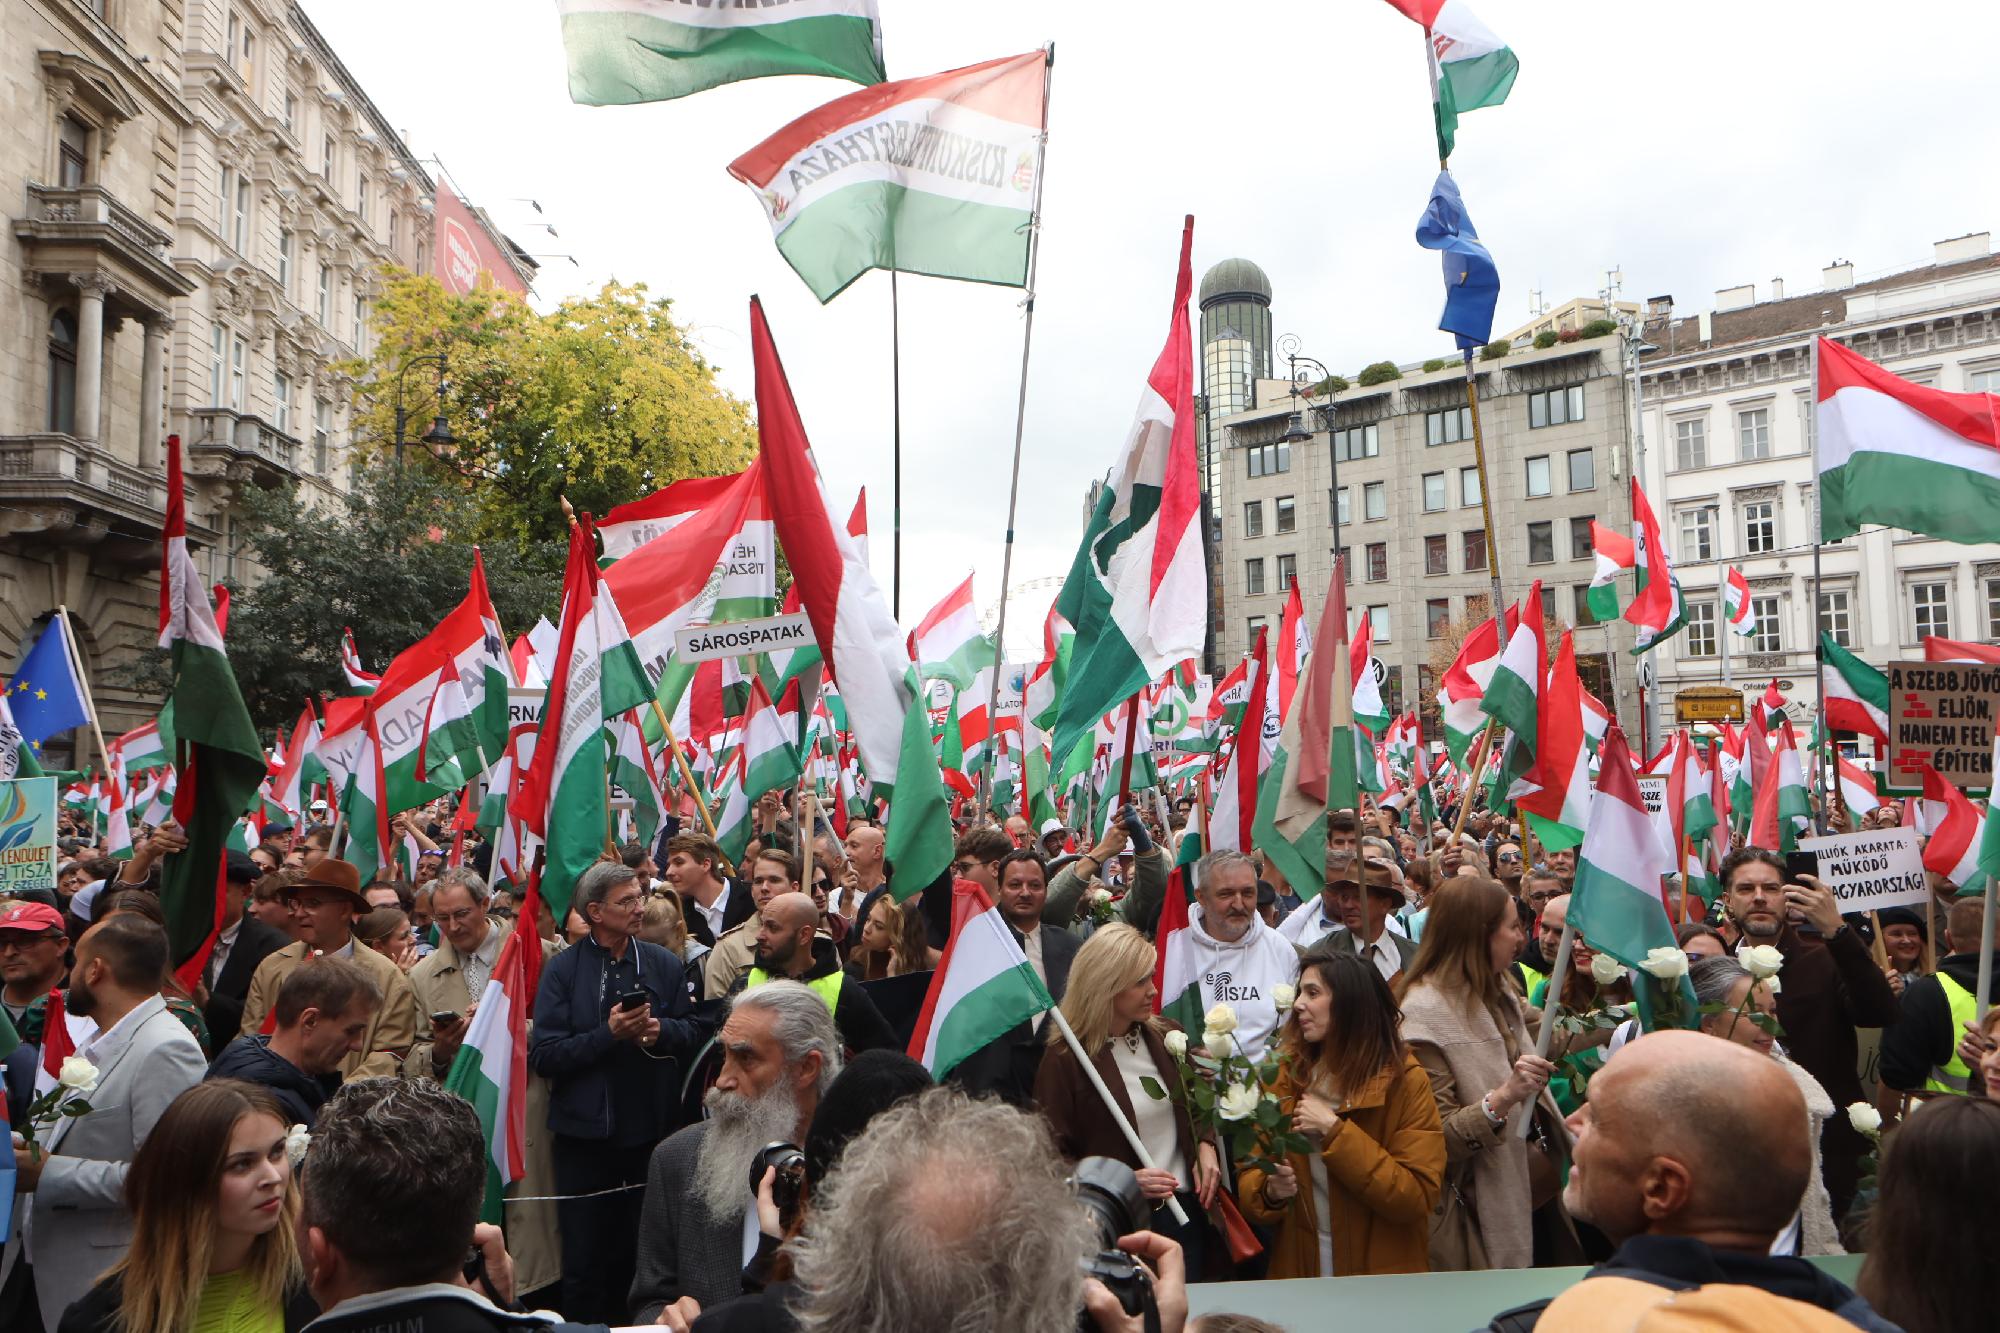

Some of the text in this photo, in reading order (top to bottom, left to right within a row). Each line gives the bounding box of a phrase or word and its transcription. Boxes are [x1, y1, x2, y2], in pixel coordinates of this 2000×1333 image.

[689, 624, 804, 653] SÁROSPATAK
[1906, 670, 1959, 692] SZEBB
[1938, 695, 1993, 722] ELJÖN,
[1900, 724, 1990, 746] HANEM FEL
[1934, 747, 1993, 773] ÉPÍTEN
[1, 844, 52, 865] LENDÜLET
[1832, 872, 1926, 900] AGYARORSZÁG!
